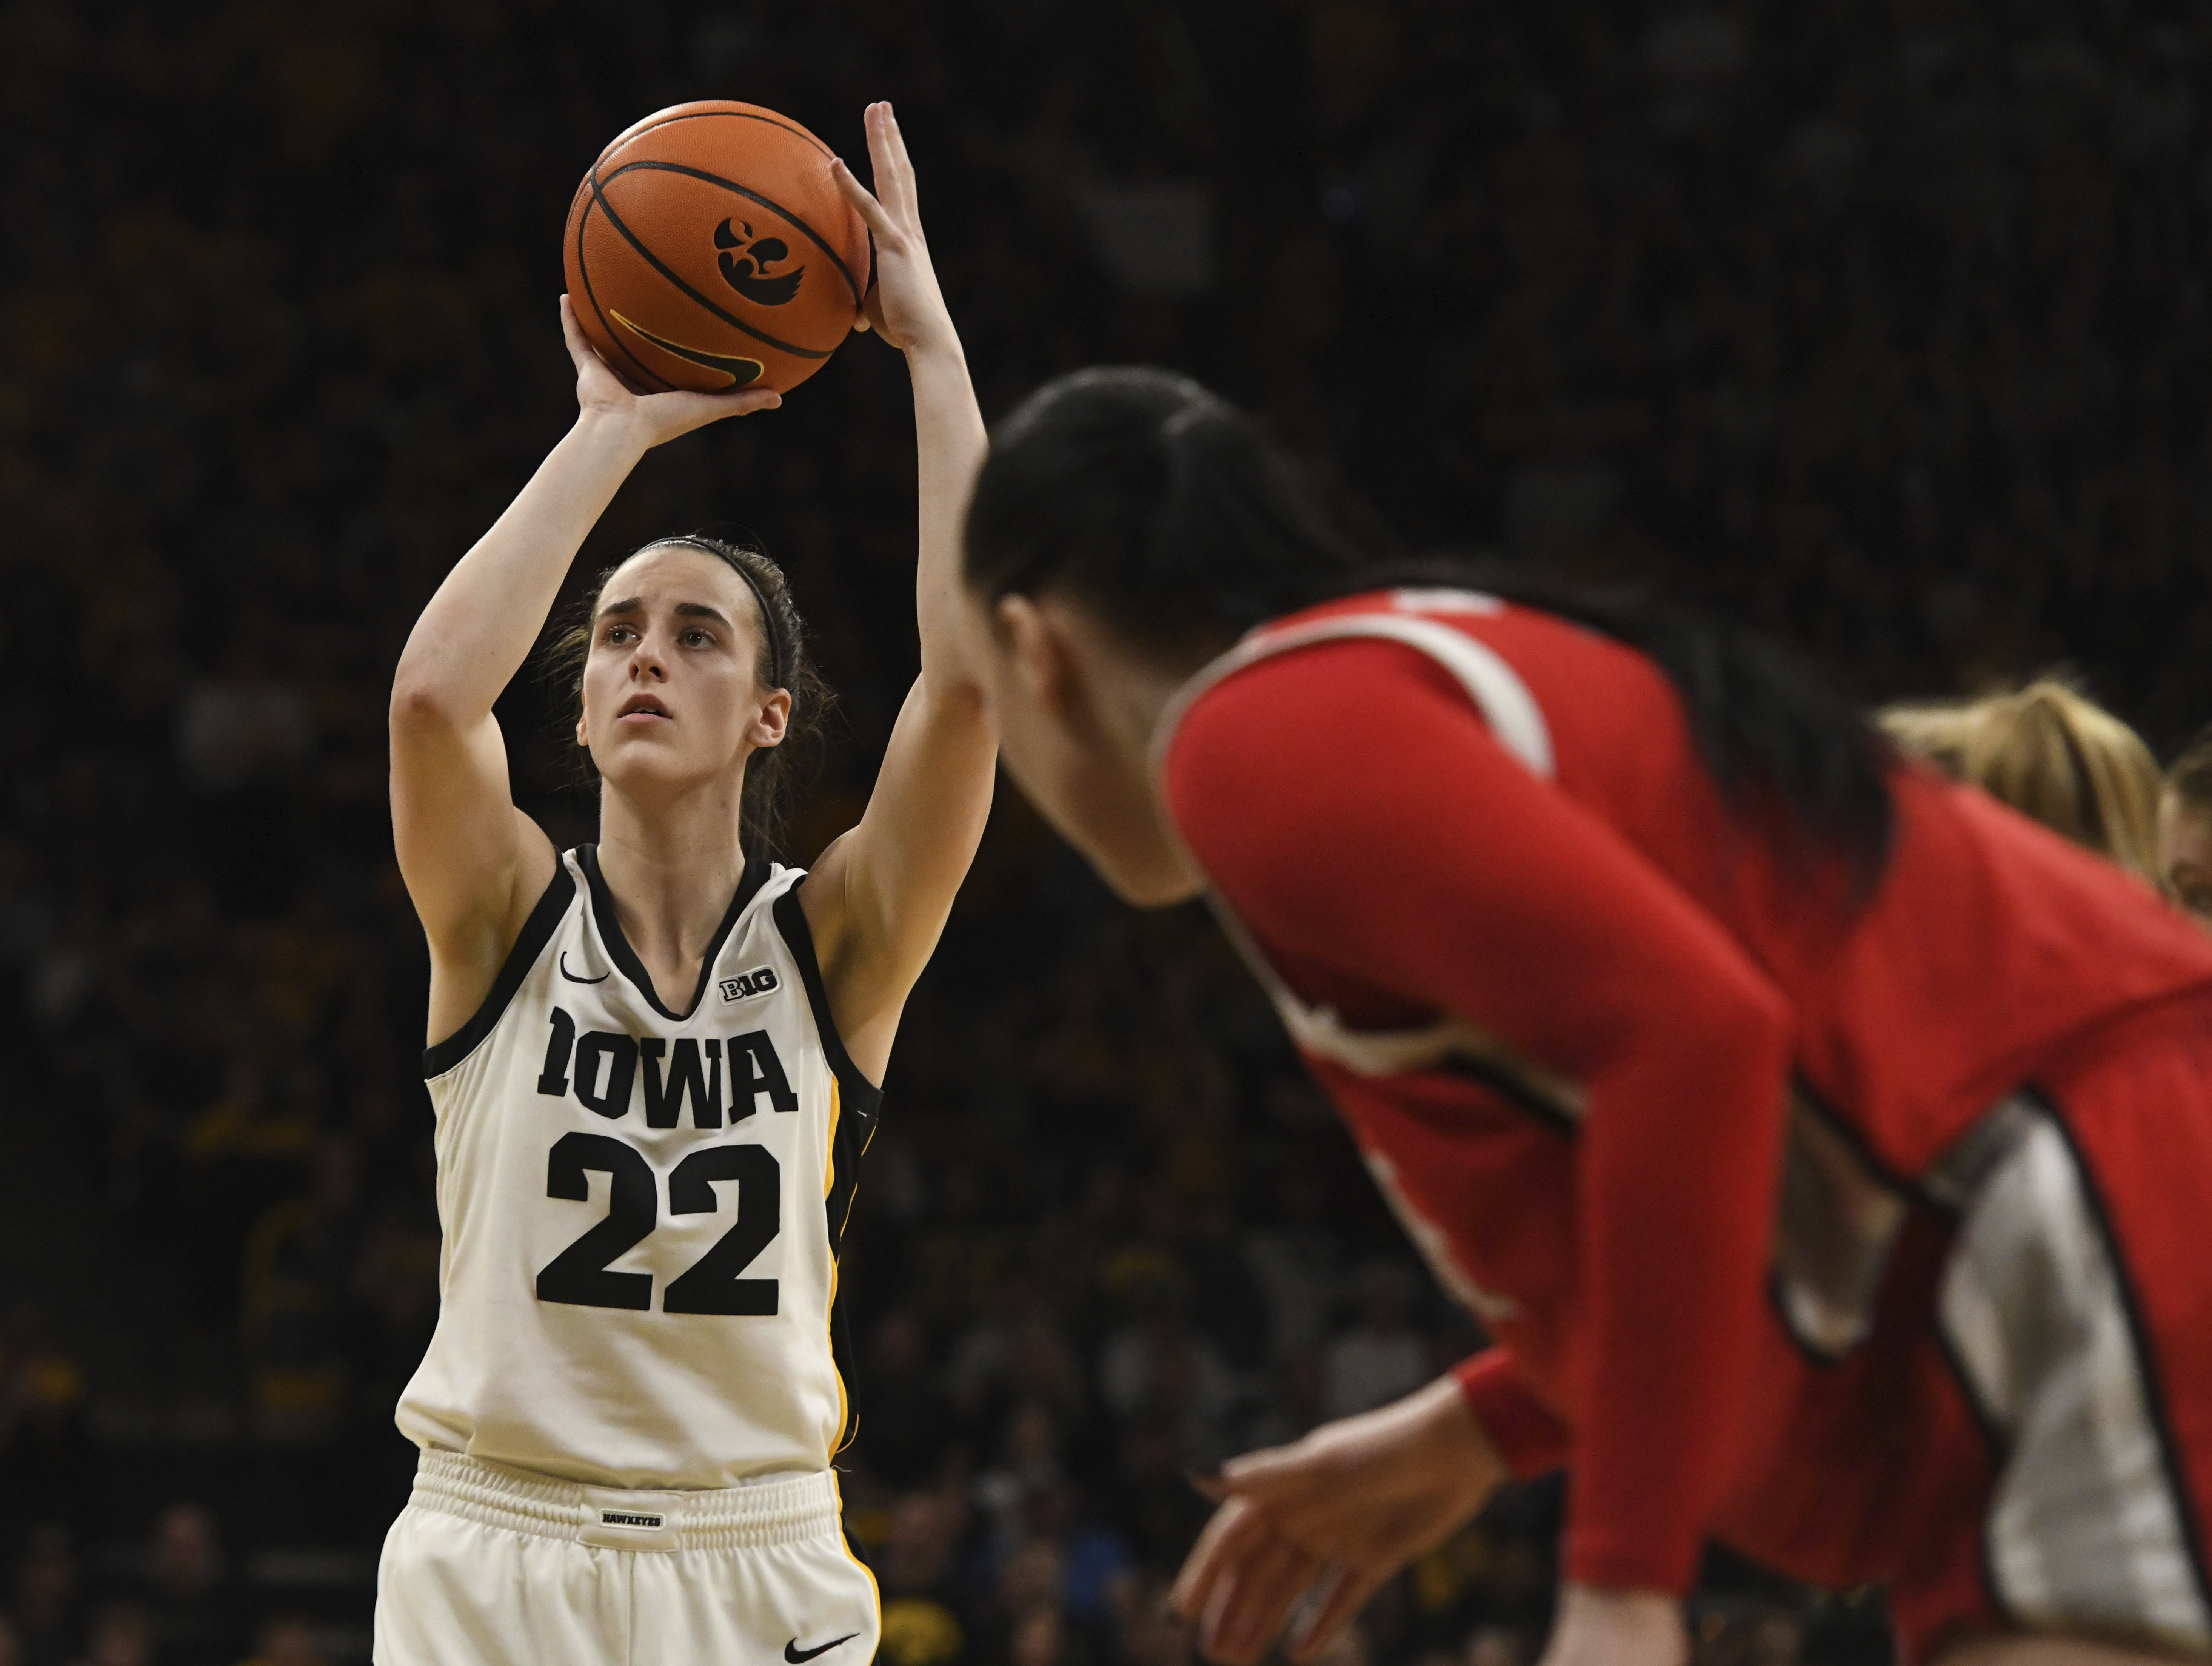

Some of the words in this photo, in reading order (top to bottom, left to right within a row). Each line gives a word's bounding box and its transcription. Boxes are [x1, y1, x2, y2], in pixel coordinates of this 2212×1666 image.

[537, 1006, 799, 1129] IOWA
[536, 1131, 780, 1316] 22
[603, 1513, 660, 1526] HAWKEYES
